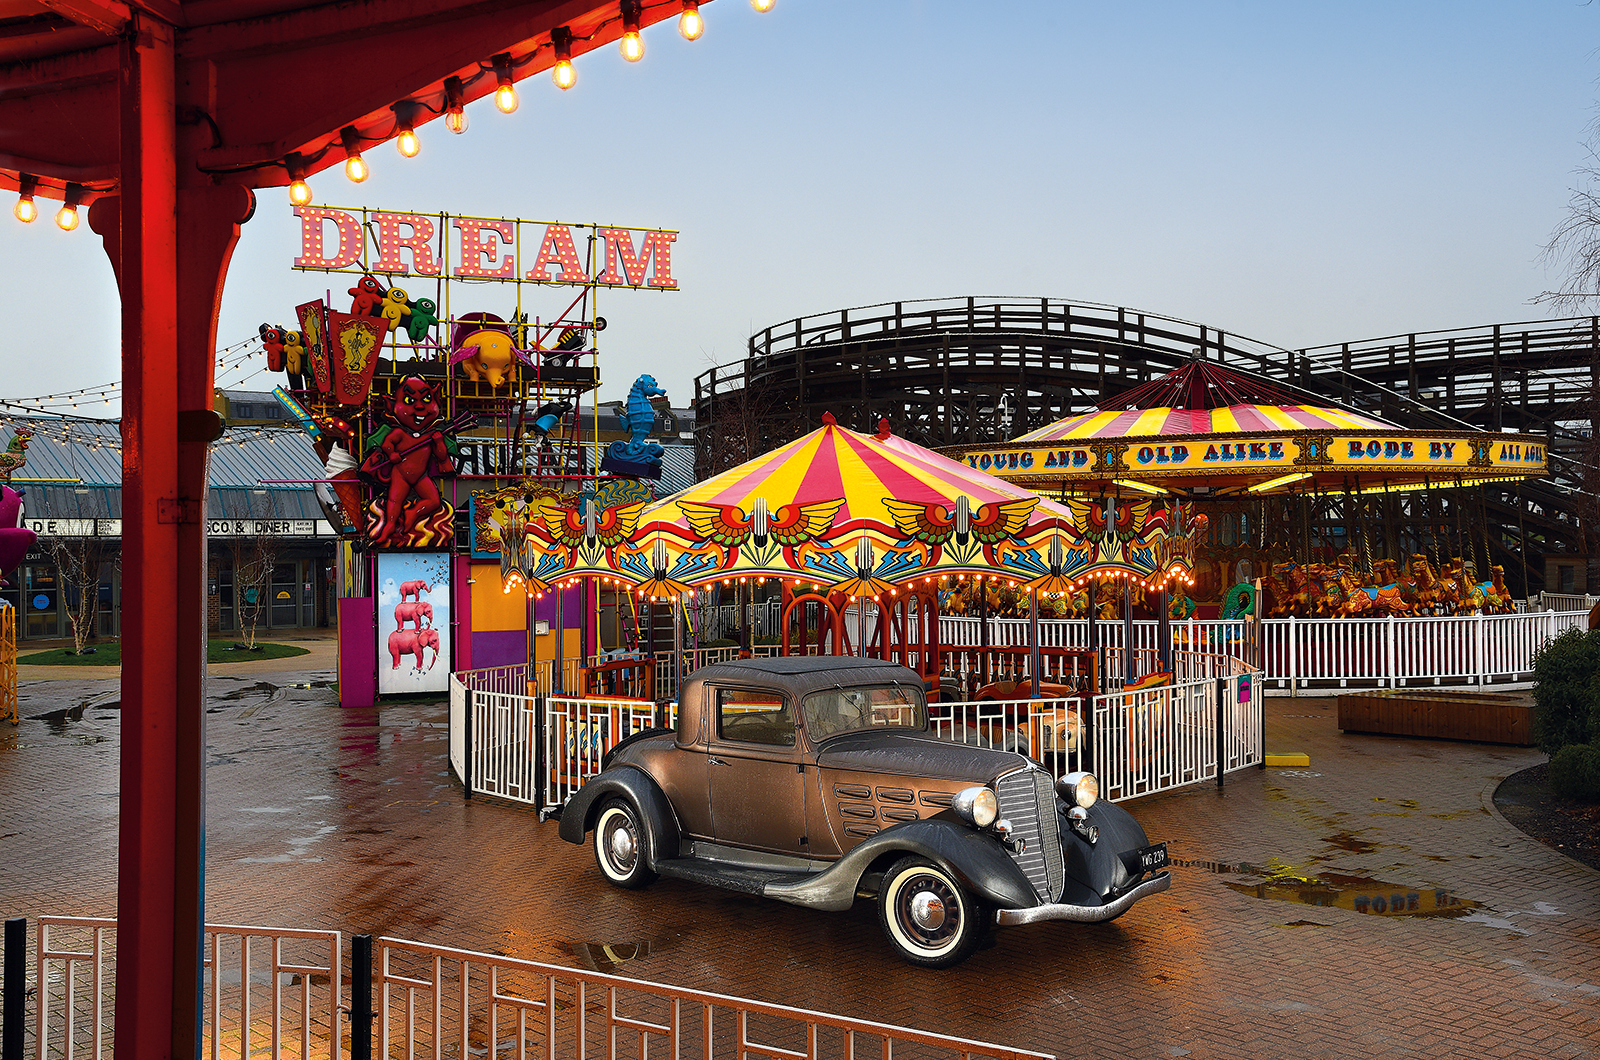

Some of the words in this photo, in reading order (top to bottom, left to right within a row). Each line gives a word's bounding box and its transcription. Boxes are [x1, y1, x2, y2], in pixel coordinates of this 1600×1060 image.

[293, 205, 678, 288] DREAM
[1136, 445, 1191, 466] OLD
[1202, 442, 1286, 462] ALIKE
[1347, 439, 1415, 460] RODE
[1428, 441, 1457, 460] BY
[1499, 444, 1521, 462] ALL
[967, 451, 1034, 471] YOUNG
[1044, 449, 1090, 468] AND
[26, 521, 57, 533] DE
[235, 521, 245, 533] &
[255, 521, 290, 533] DINER
[1153, 849, 1164, 863] 239
